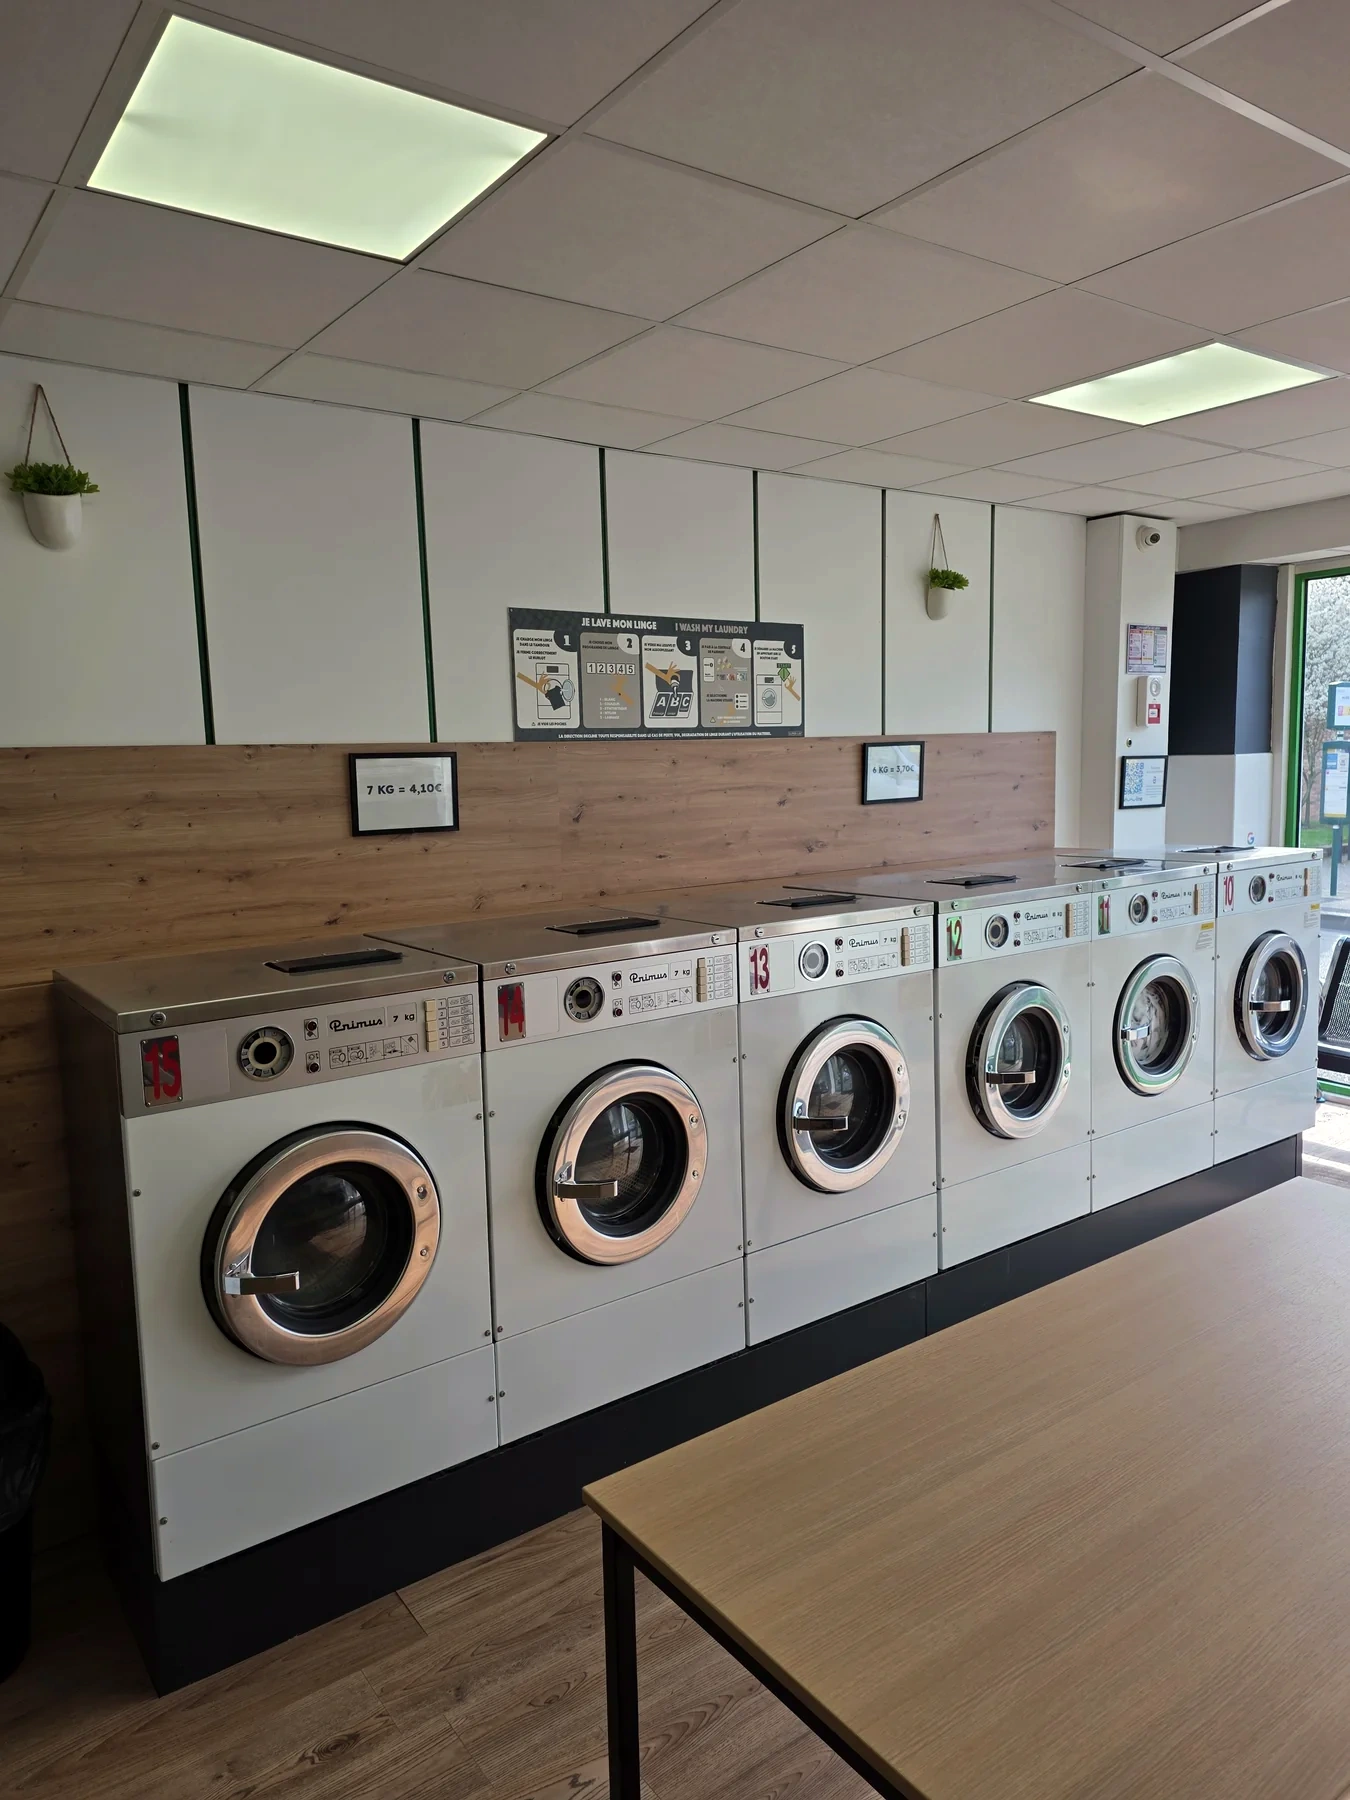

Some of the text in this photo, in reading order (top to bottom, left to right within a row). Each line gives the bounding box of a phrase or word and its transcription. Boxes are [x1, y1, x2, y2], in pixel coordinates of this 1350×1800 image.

[581, 617, 657, 630] JE LAVE MON LINGE
[675, 622, 749, 635] I WASH MY LAUNDRY
[563, 634, 571, 646] 1
[626, 637, 633, 649] 2
[684, 640, 692, 651] 3
[739, 642, 747, 653] 4
[791, 644, 797, 655] 5
[588, 663, 634, 674] 1 2 3 4 5
[656, 696, 690, 707] A B C
[872, 766, 877, 774] 6
[879, 766, 889, 774] KG
[366, 785, 374, 795] 7
[377, 784, 395, 795] KG
[409, 783, 442, 796] 4,10€
[1223, 876, 1234, 906] 10
[1024, 912, 1049, 921] Primus
[848, 938, 879, 948] Primus
[946, 919, 963, 957] 12
[682, 968, 691, 976] kg
[750, 947, 770, 990] 13
[629, 972, 668, 983] Primus
[498, 985, 525, 1036] 14
[404, 1013, 415, 1021] kg
[329, 1018, 383, 1032] Primus
[144, 1040, 181, 1100] 15
